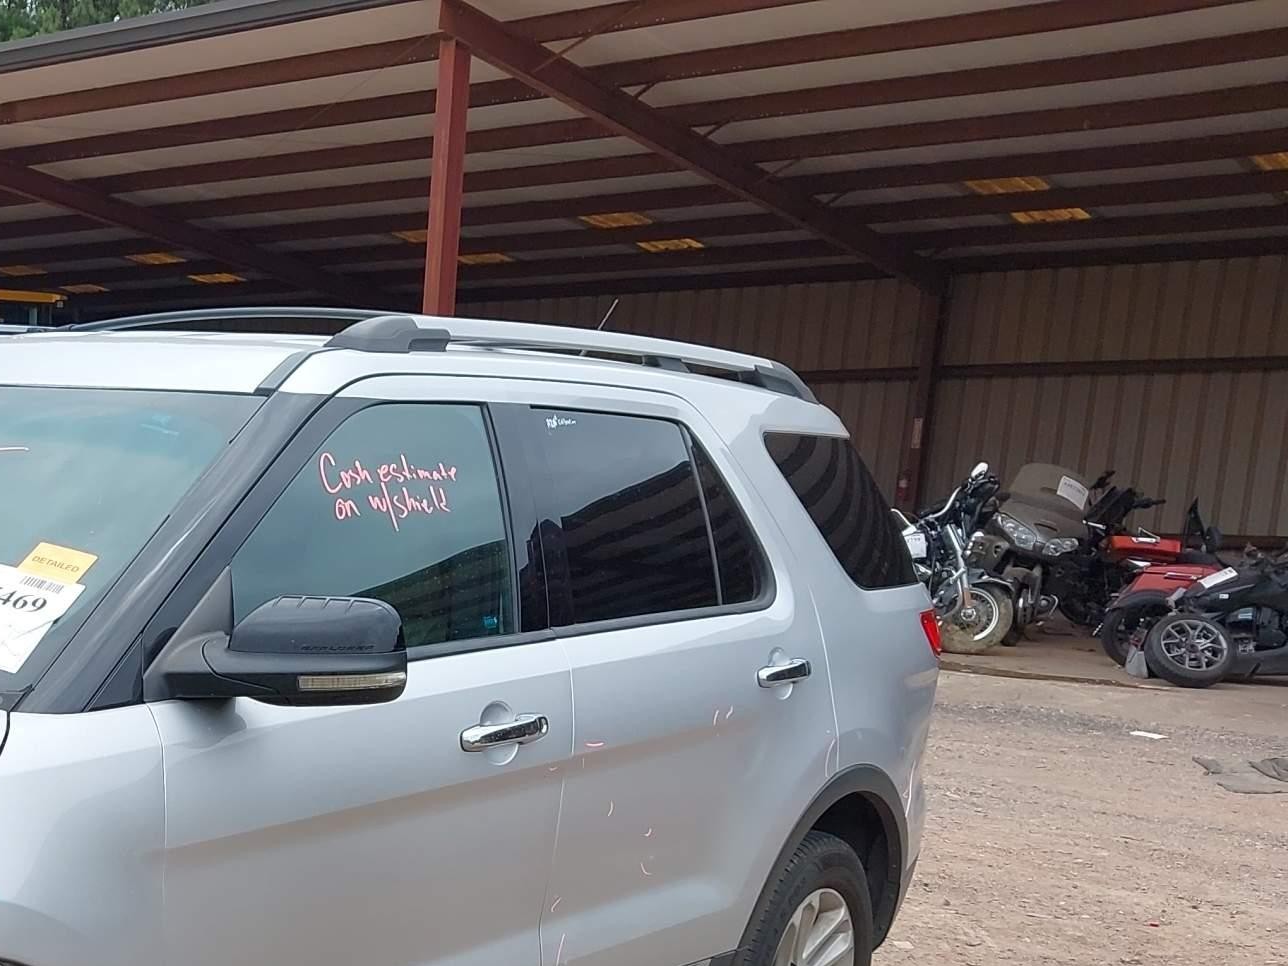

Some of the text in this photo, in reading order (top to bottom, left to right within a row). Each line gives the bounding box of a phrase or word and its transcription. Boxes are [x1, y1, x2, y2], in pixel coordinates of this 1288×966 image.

[377, 453, 457, 483] estimate
[335, 497, 361, 520] on
[31, 554, 80, 574] DETAILED
